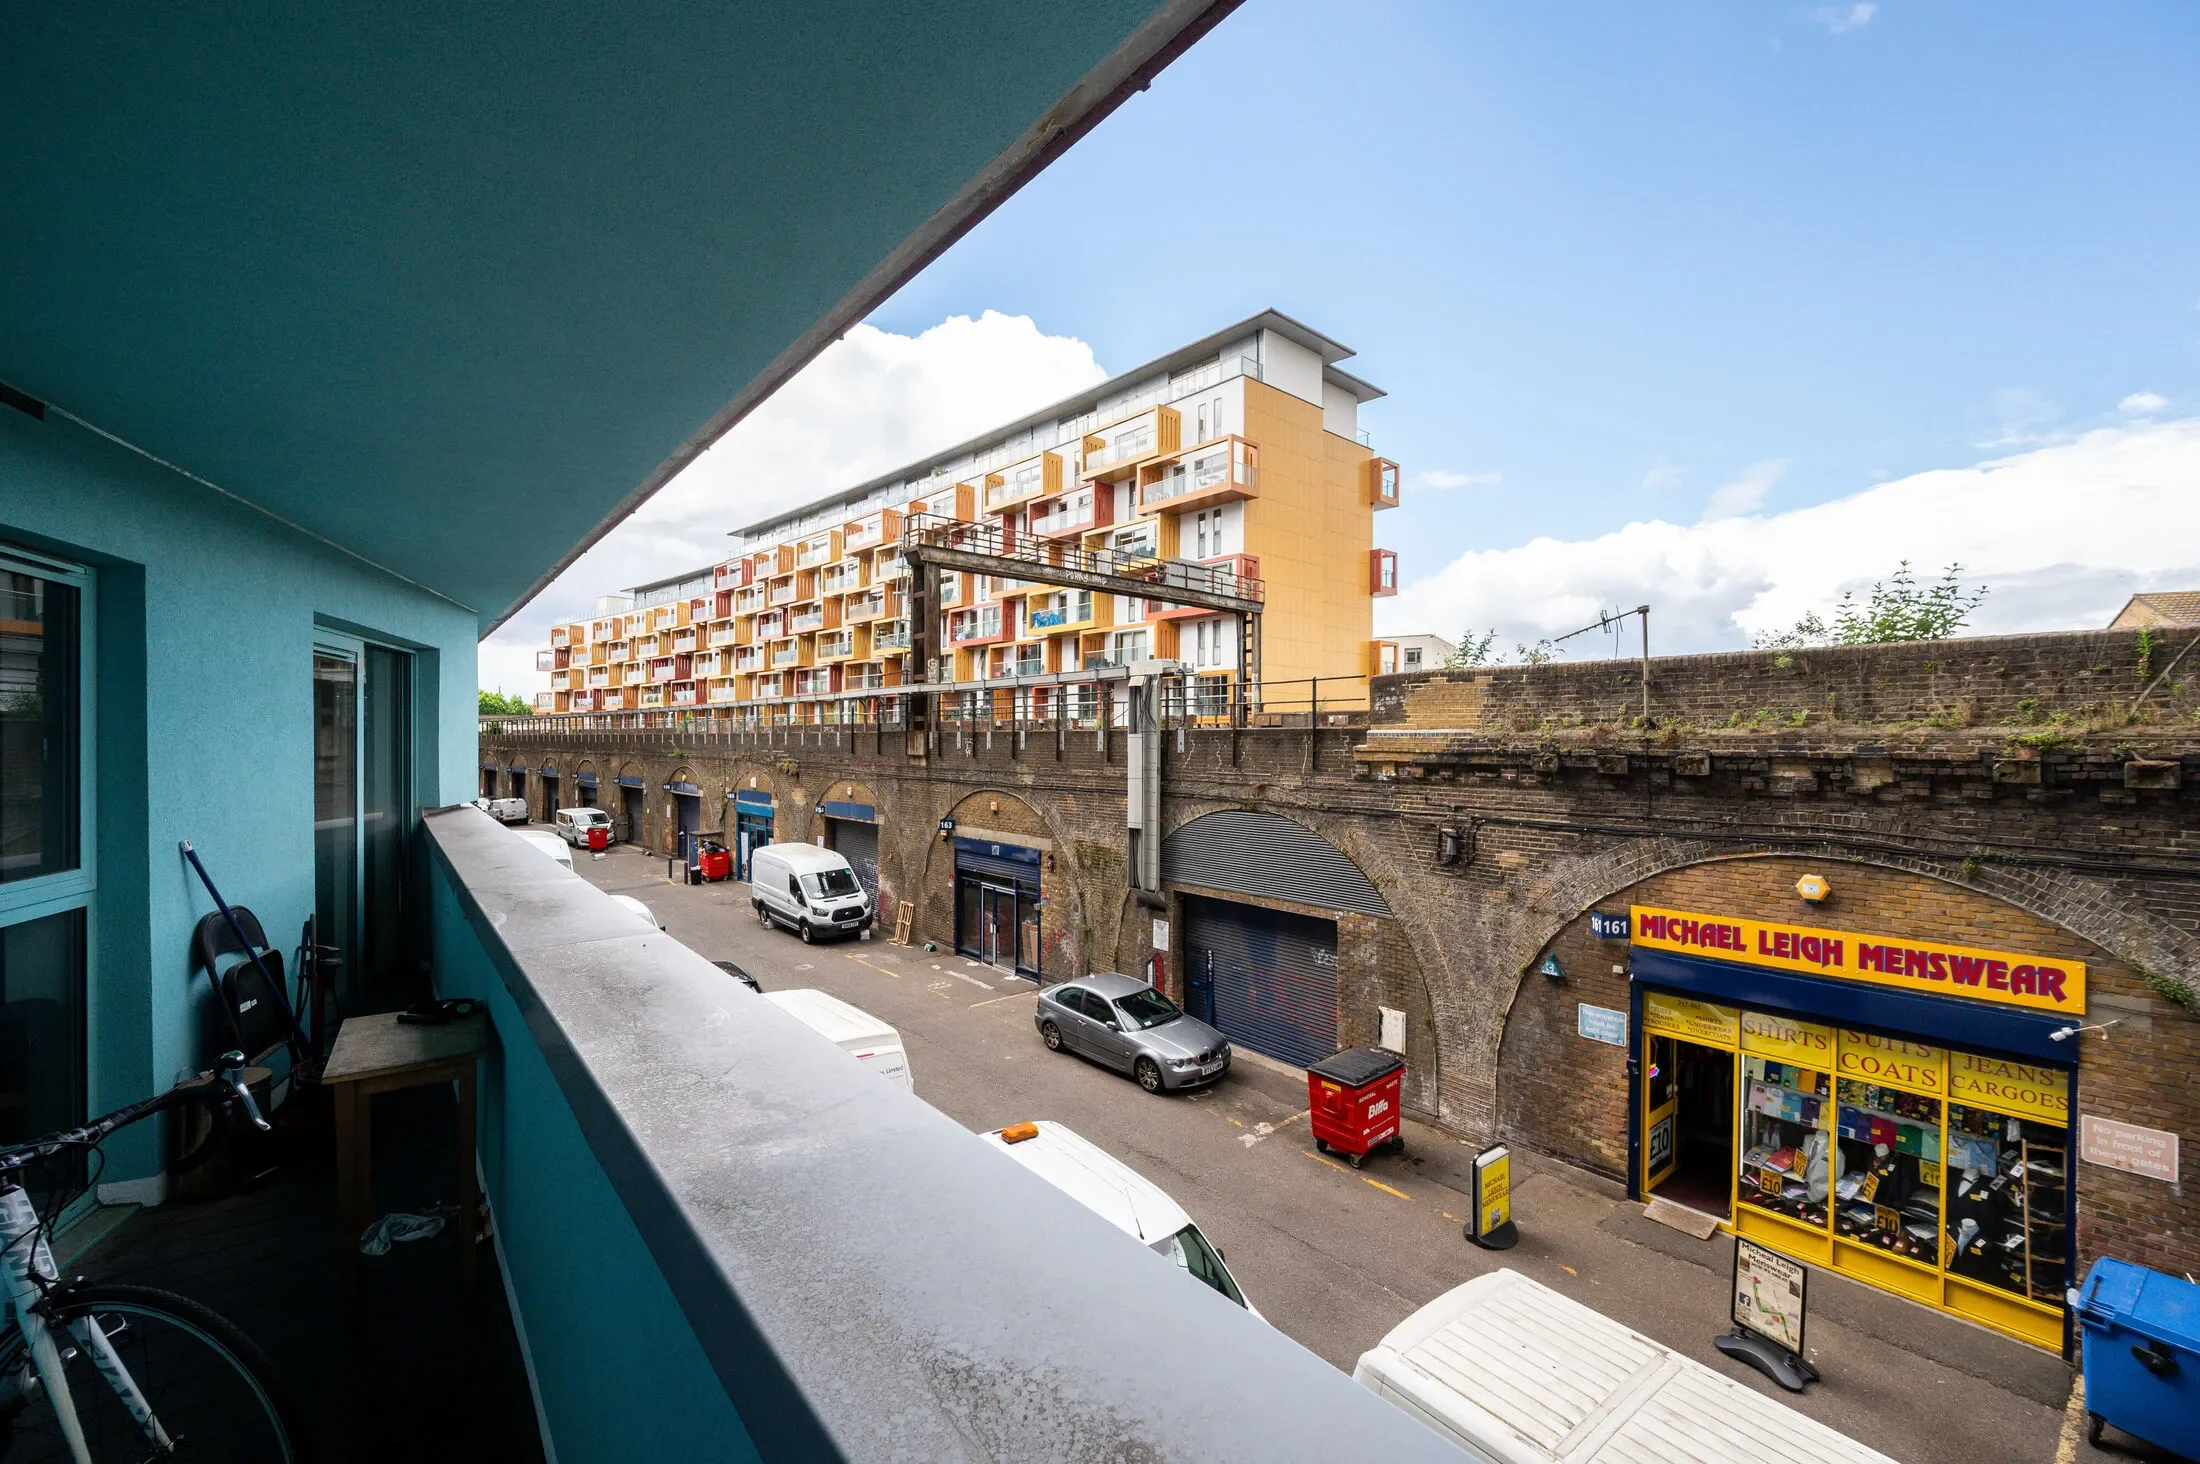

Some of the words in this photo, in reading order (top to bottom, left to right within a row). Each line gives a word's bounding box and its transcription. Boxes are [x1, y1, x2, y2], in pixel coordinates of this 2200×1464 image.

[940, 821, 953, 829] 163
[1603, 920, 1628, 935] 161
[1640, 913, 1748, 952] MICHAEL
[1758, 930, 1844, 968] LEIGH
[1858, 942, 2068, 1003] MENSWEAR
[1743, 1018, 1828, 1050] SHIRTS
[885, 1064, 904, 1075] Limited
[1840, 1052, 1937, 1088] COATS
[1963, 1055, 2055, 1087] JEANS
[1951, 1075, 2068, 1111] CARGOES
[1367, 1098, 1389, 1120] Biffa
[1650, 1126, 1669, 1161] £10
[2092, 1123, 2112, 1135] No
[2115, 1130, 2166, 1148] parking
[2089, 1146, 2127, 1162] these
[2131, 1157, 2170, 1172] gates
[2112, 1139, 2144, 1155] front
[2147, 1149, 2162, 1158] of
[1484, 1173, 1506, 1189] MICHAEL
[1761, 1178, 1781, 1195] £10
[1481, 1188, 1510, 1209] MENSWEAR
[1877, 1215, 1898, 1235] £10
[1741, 1242, 1774, 1263] Micheal
[1776, 1259, 1800, 1276] Leigh
[1748, 1253, 1792, 1279] Menswear
